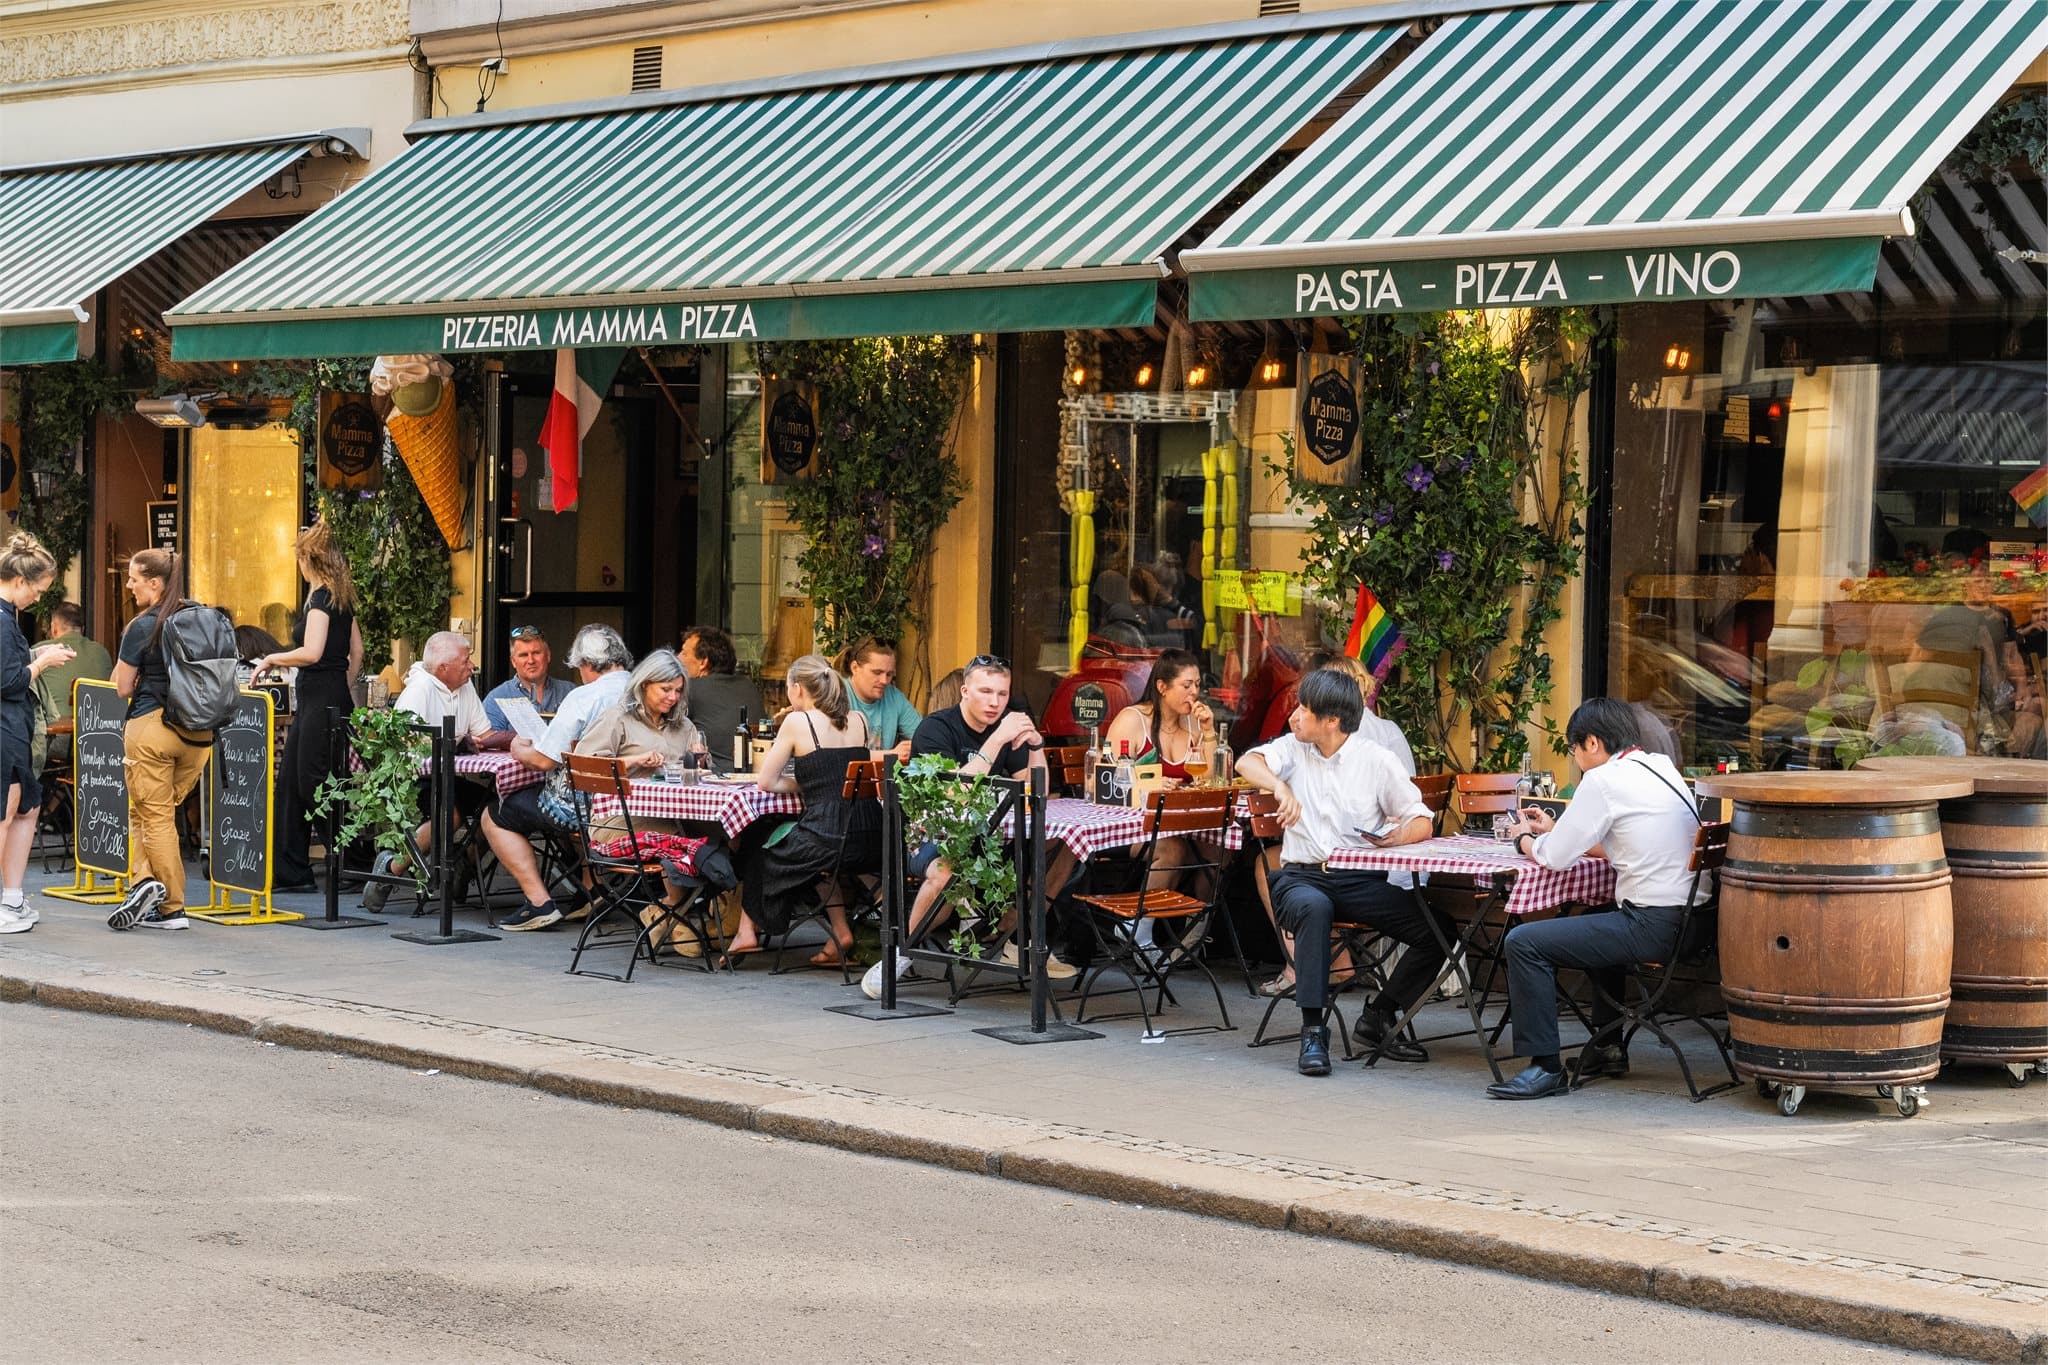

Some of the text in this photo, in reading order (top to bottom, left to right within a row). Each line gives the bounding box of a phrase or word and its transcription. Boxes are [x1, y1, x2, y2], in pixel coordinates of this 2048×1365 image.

[1296, 268, 1403, 312] PASTA
[1455, 258, 1568, 305] PIZZA
[1626, 250, 1741, 297] VINO
[442, 303, 758, 350] PIZZERIA MAMMA PIZZA
[1310, 397, 1352, 423] Mamma
[331, 423, 374, 444] Mamma
[1315, 418, 1344, 441] Pizza
[337, 440, 366, 458] Pizza
[1075, 696, 1104, 708] Mamma
[1079, 707, 1098, 718] Pizza
[88, 796, 120, 830] Grazie
[92, 824, 126, 861] Mille
[224, 846, 257, 872] Mille
